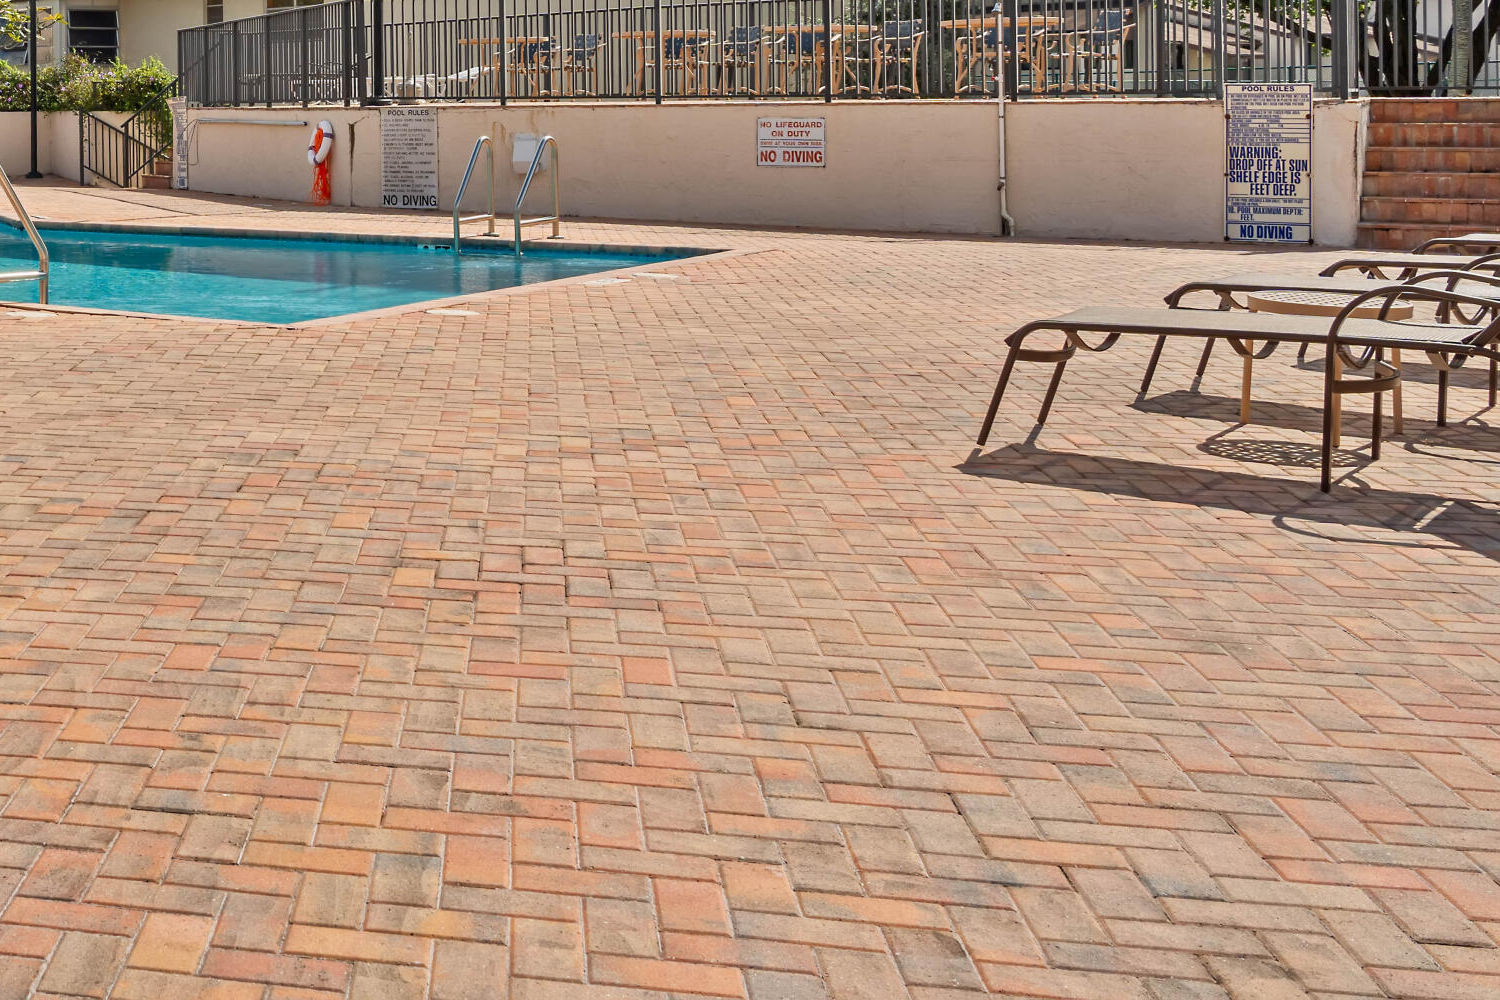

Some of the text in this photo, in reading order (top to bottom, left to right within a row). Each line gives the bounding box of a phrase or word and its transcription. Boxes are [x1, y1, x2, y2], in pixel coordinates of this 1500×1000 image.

[760, 150, 823, 163] NO DIVING
[1229, 146, 1282, 159] WARNING:
[1229, 158, 1308, 172] DROP OFF AT SUN
[1229, 170, 1301, 184] SHELF EDGE IS
[1250, 183, 1297, 197] FEET DEEP.
[383, 194, 437, 207] NO DIVING
[1237, 206, 1251, 214] POOL
[1253, 206, 1281, 215] MAXIMUM
[1282, 207, 1304, 216] DEPTH:
[1240, 225, 1293, 240] NO DIVING
